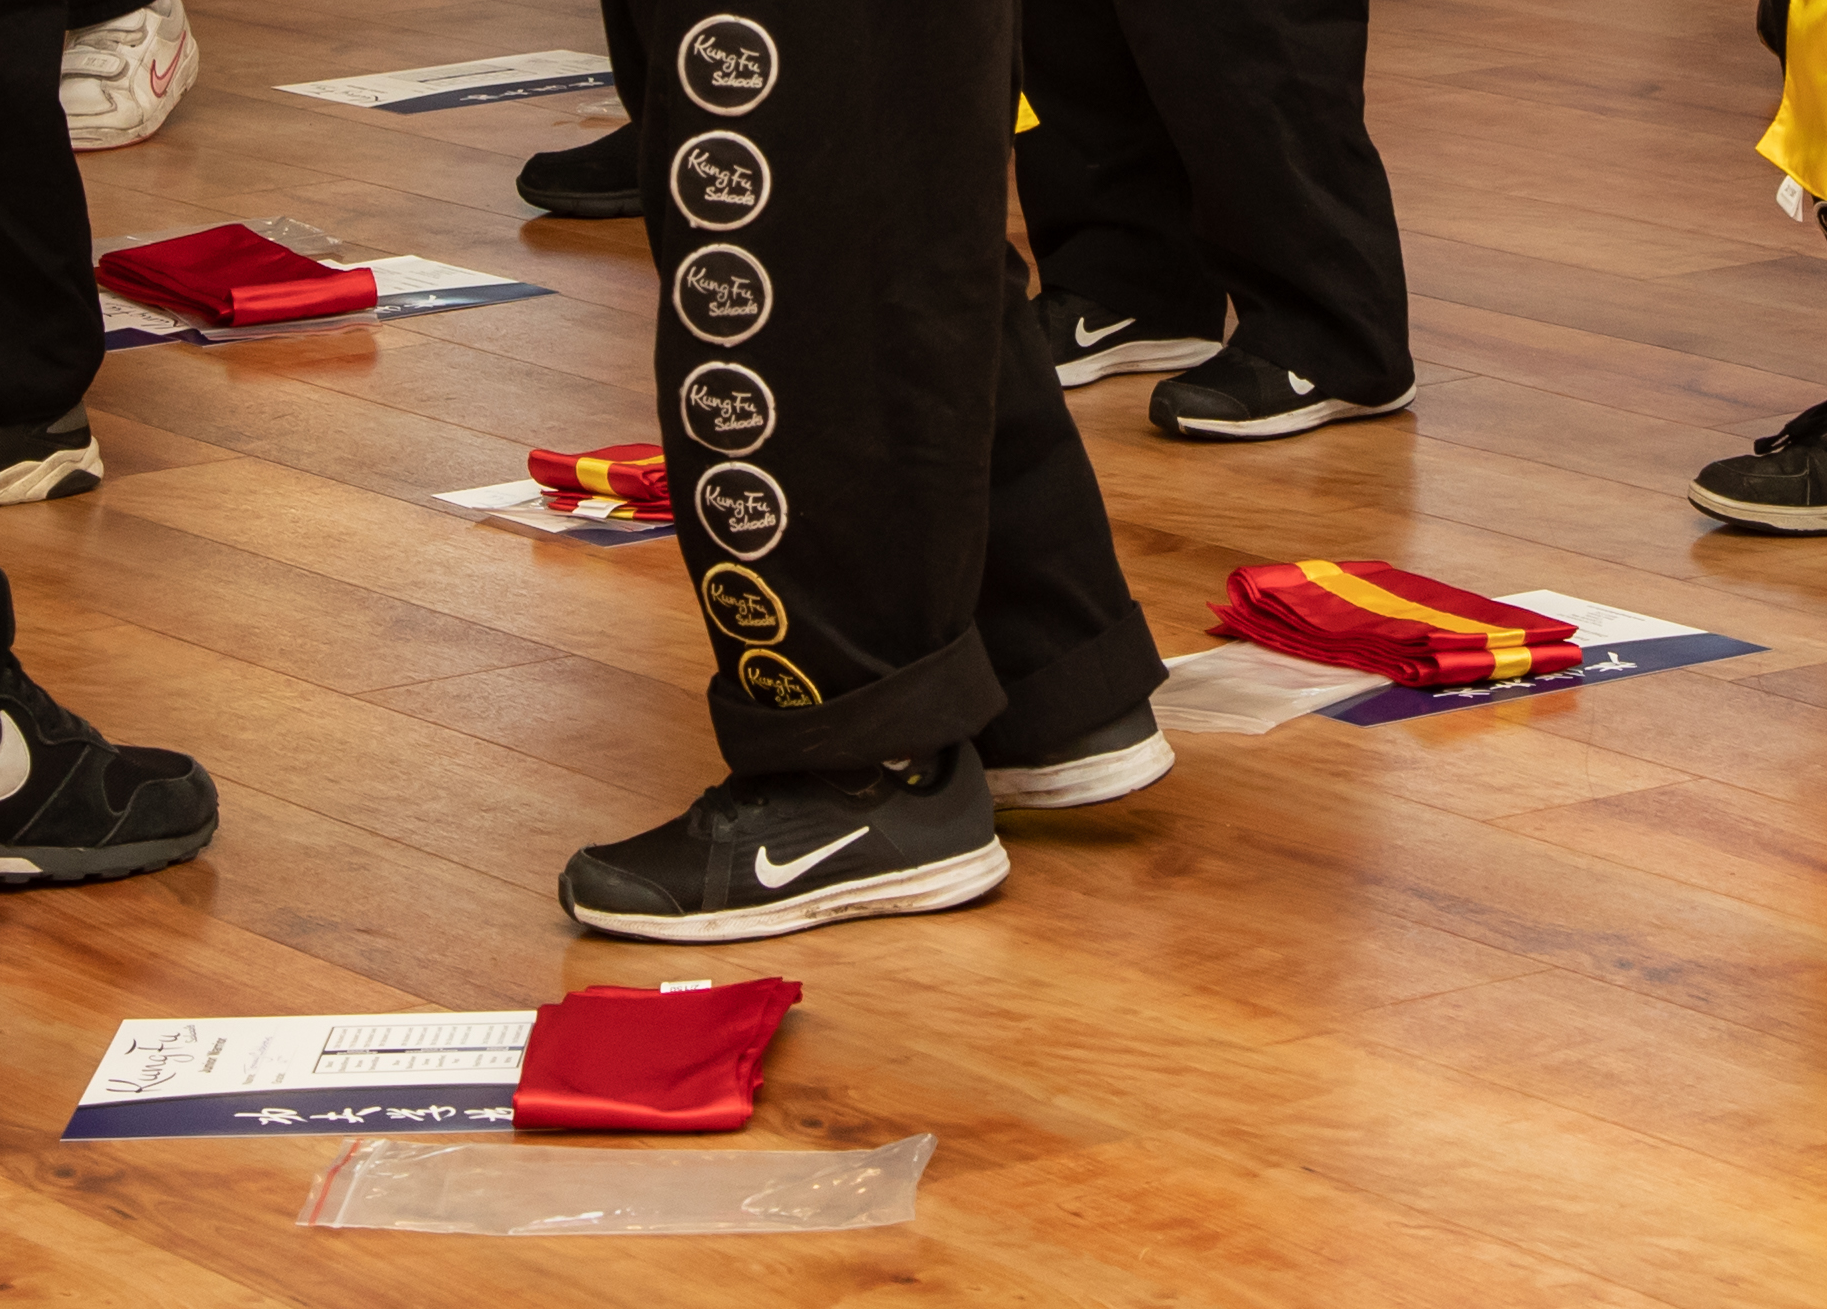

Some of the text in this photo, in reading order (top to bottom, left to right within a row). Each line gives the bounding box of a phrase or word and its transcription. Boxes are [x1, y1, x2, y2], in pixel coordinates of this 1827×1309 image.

[693, 35, 760, 72] Kung Fu
[712, 71, 763, 88] Schools
[688, 149, 752, 190] Kung Fu
[704, 186, 755, 206] Schools
[687, 266, 753, 301] Kung Fu
[709, 301, 758, 316] Schools
[690, 384, 757, 417] Kung Fu
[714, 414, 764, 431] Schools
[705, 485, 770, 517] Kung Fu
[729, 513, 776, 532] Schools
[711, 584, 767, 614] Kung Fu
[748, 668, 803, 695] Kung Fu
[106, 1032, 195, 1094] Kung Fu
